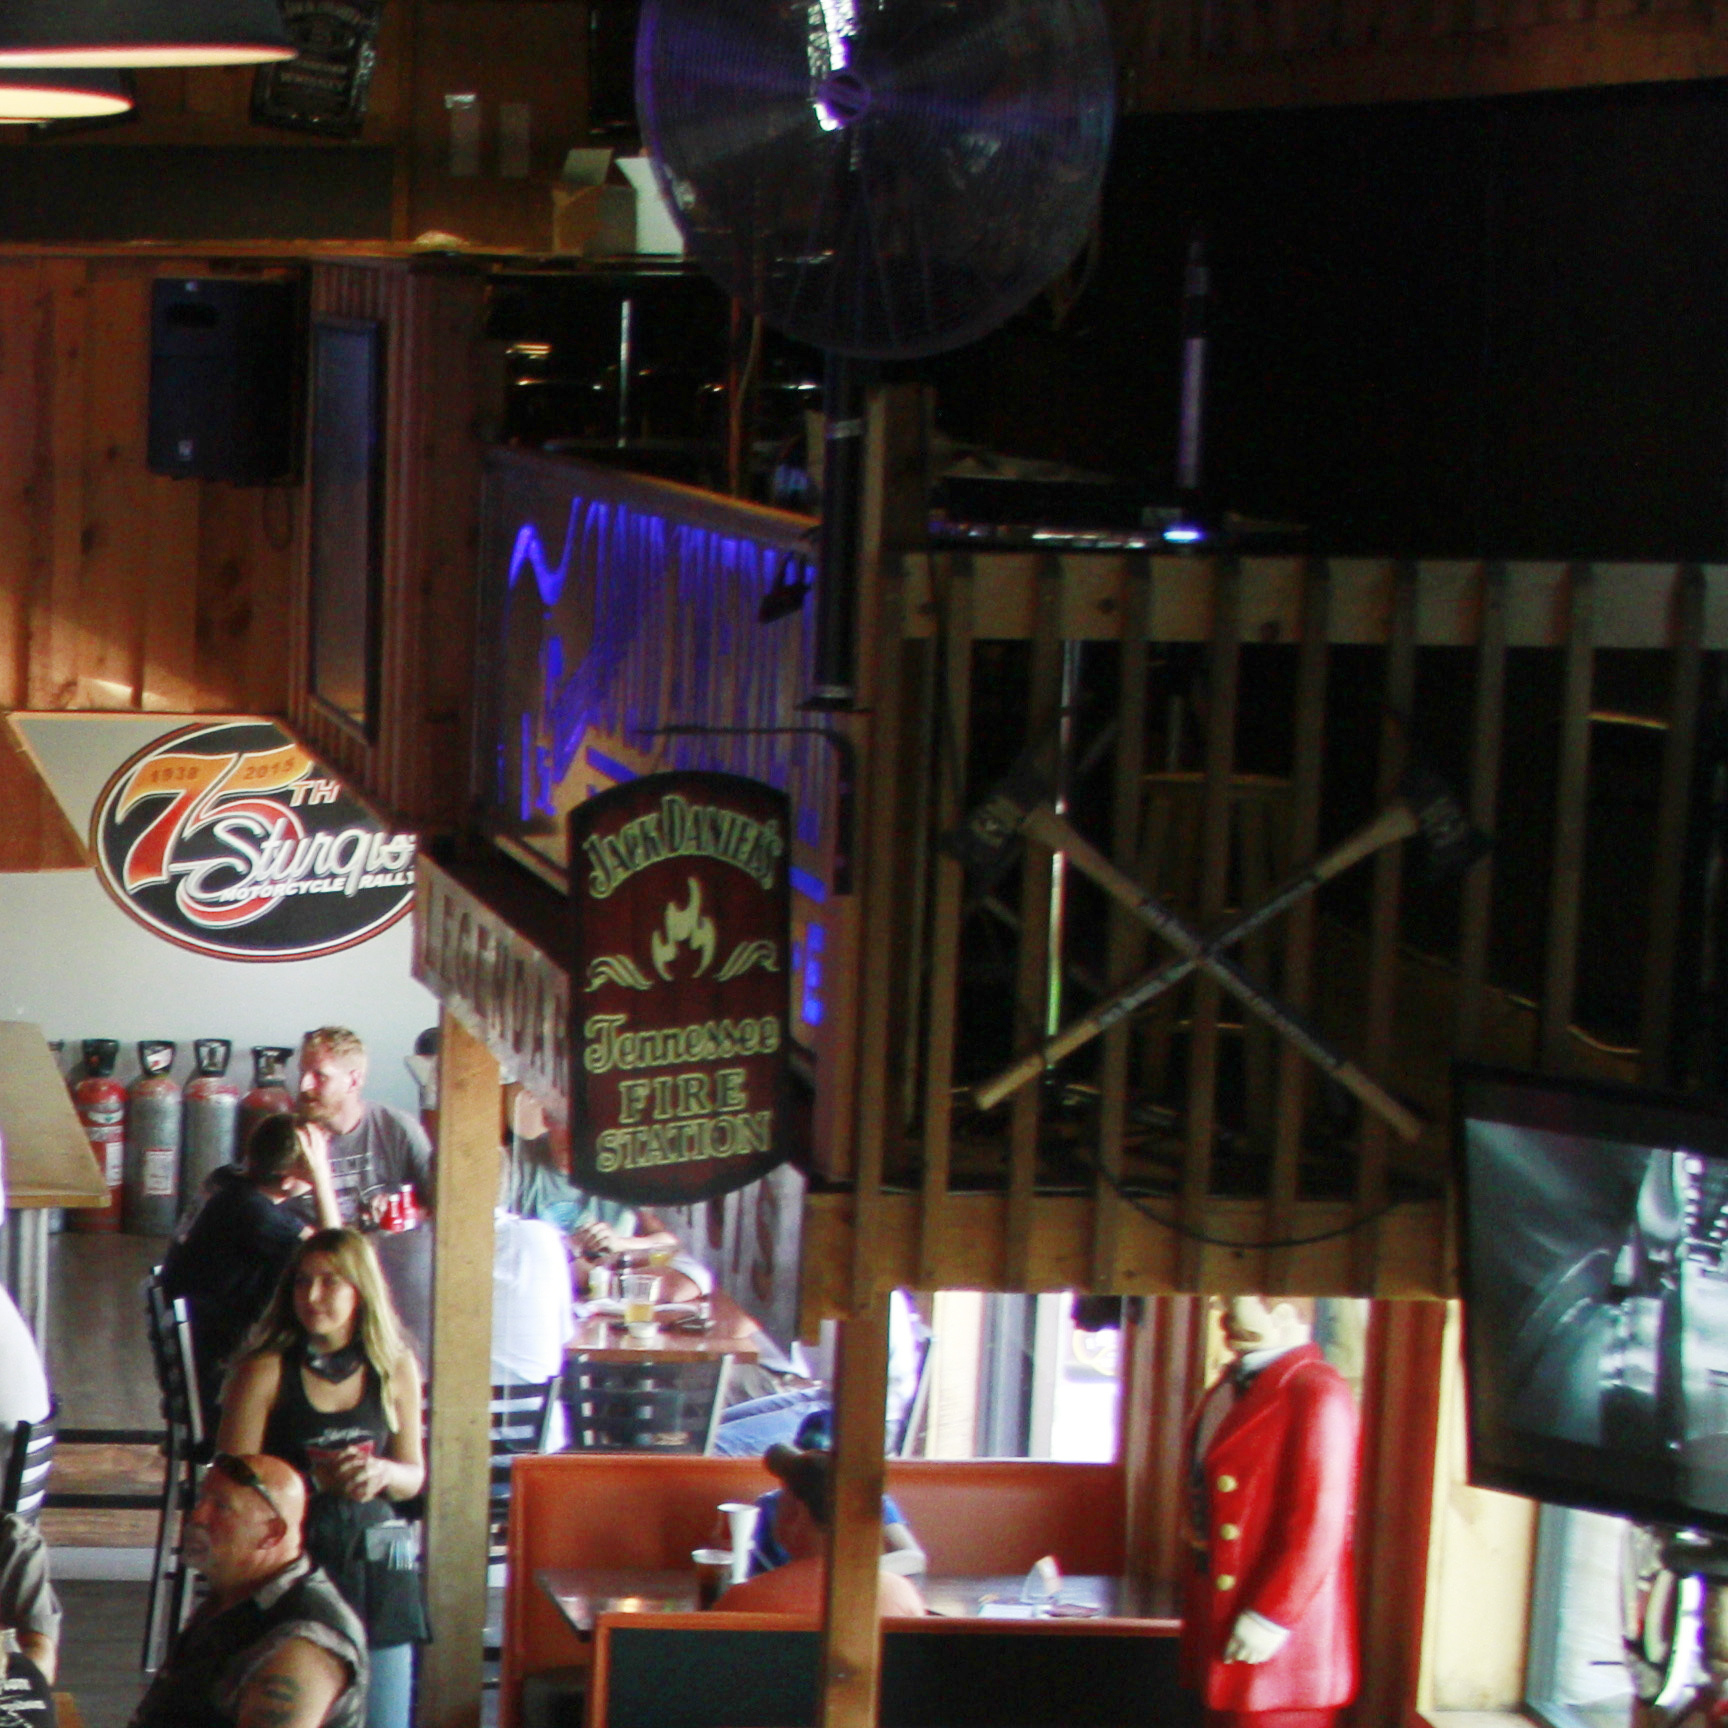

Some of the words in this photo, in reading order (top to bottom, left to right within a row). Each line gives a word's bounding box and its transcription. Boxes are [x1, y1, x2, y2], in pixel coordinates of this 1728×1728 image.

[168, 816, 417, 898] Sturgis
[582, 812, 661, 899] JACK
[218, 878, 346, 903] MOTORCYCLE
[424, 876, 569, 1098] LEGENDAR
[583, 1014, 782, 1075] Tennessee
[617, 1068, 749, 1125] FIRE
[595, 1109, 774, 1173] STATION
